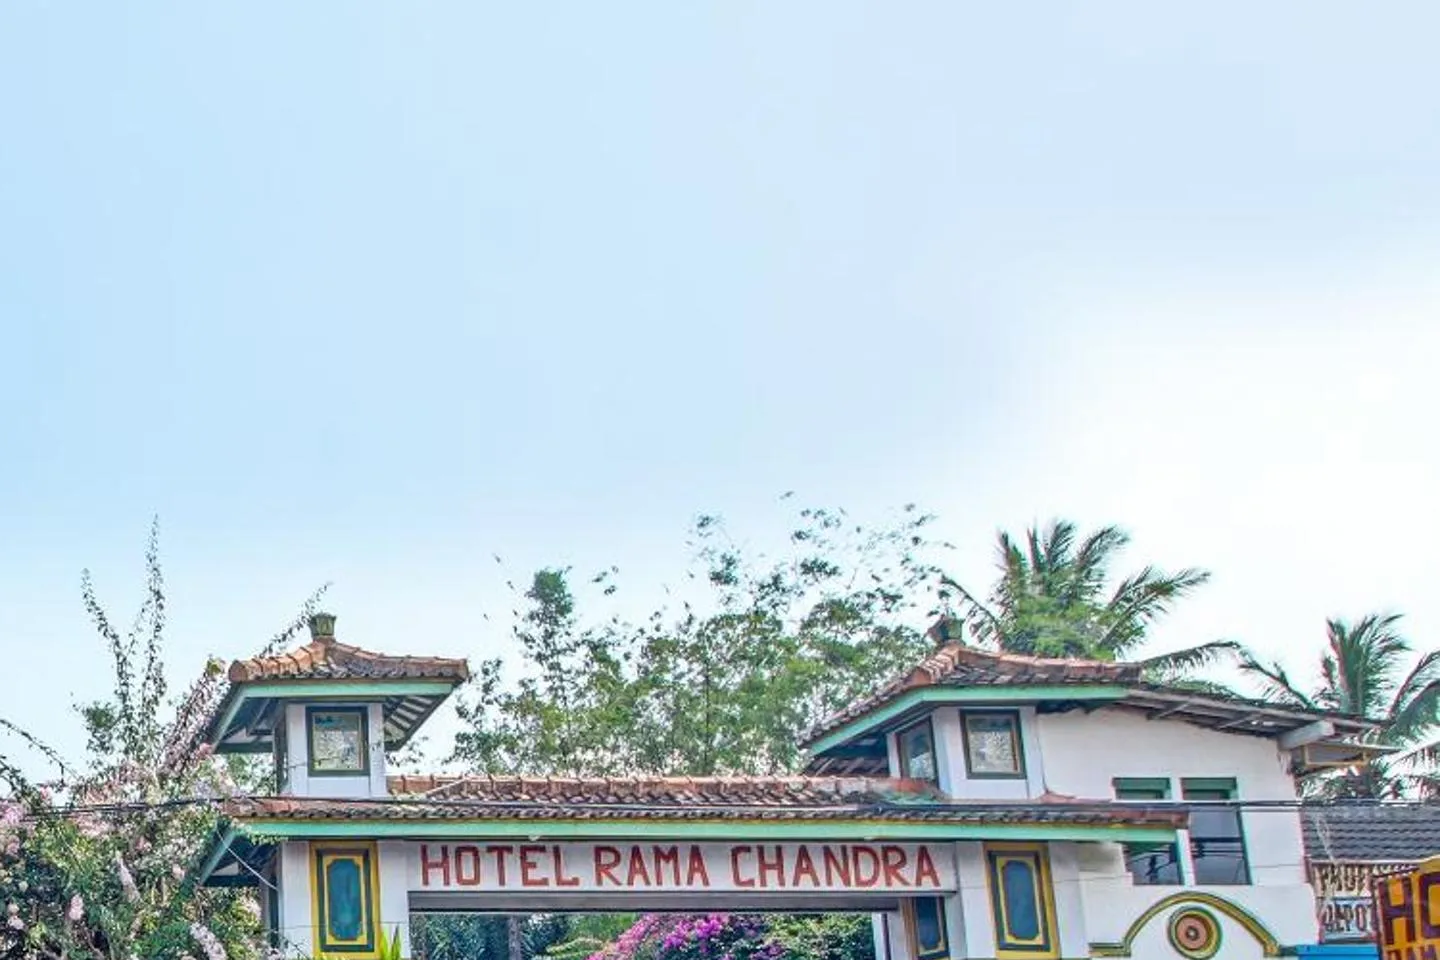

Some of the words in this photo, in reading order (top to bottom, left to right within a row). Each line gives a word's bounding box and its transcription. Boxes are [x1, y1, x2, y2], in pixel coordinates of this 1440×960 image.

[420, 844, 580, 888] HOTEL
[593, 844, 711, 888] RAMA
[730, 844, 942, 889] CHANDRA
